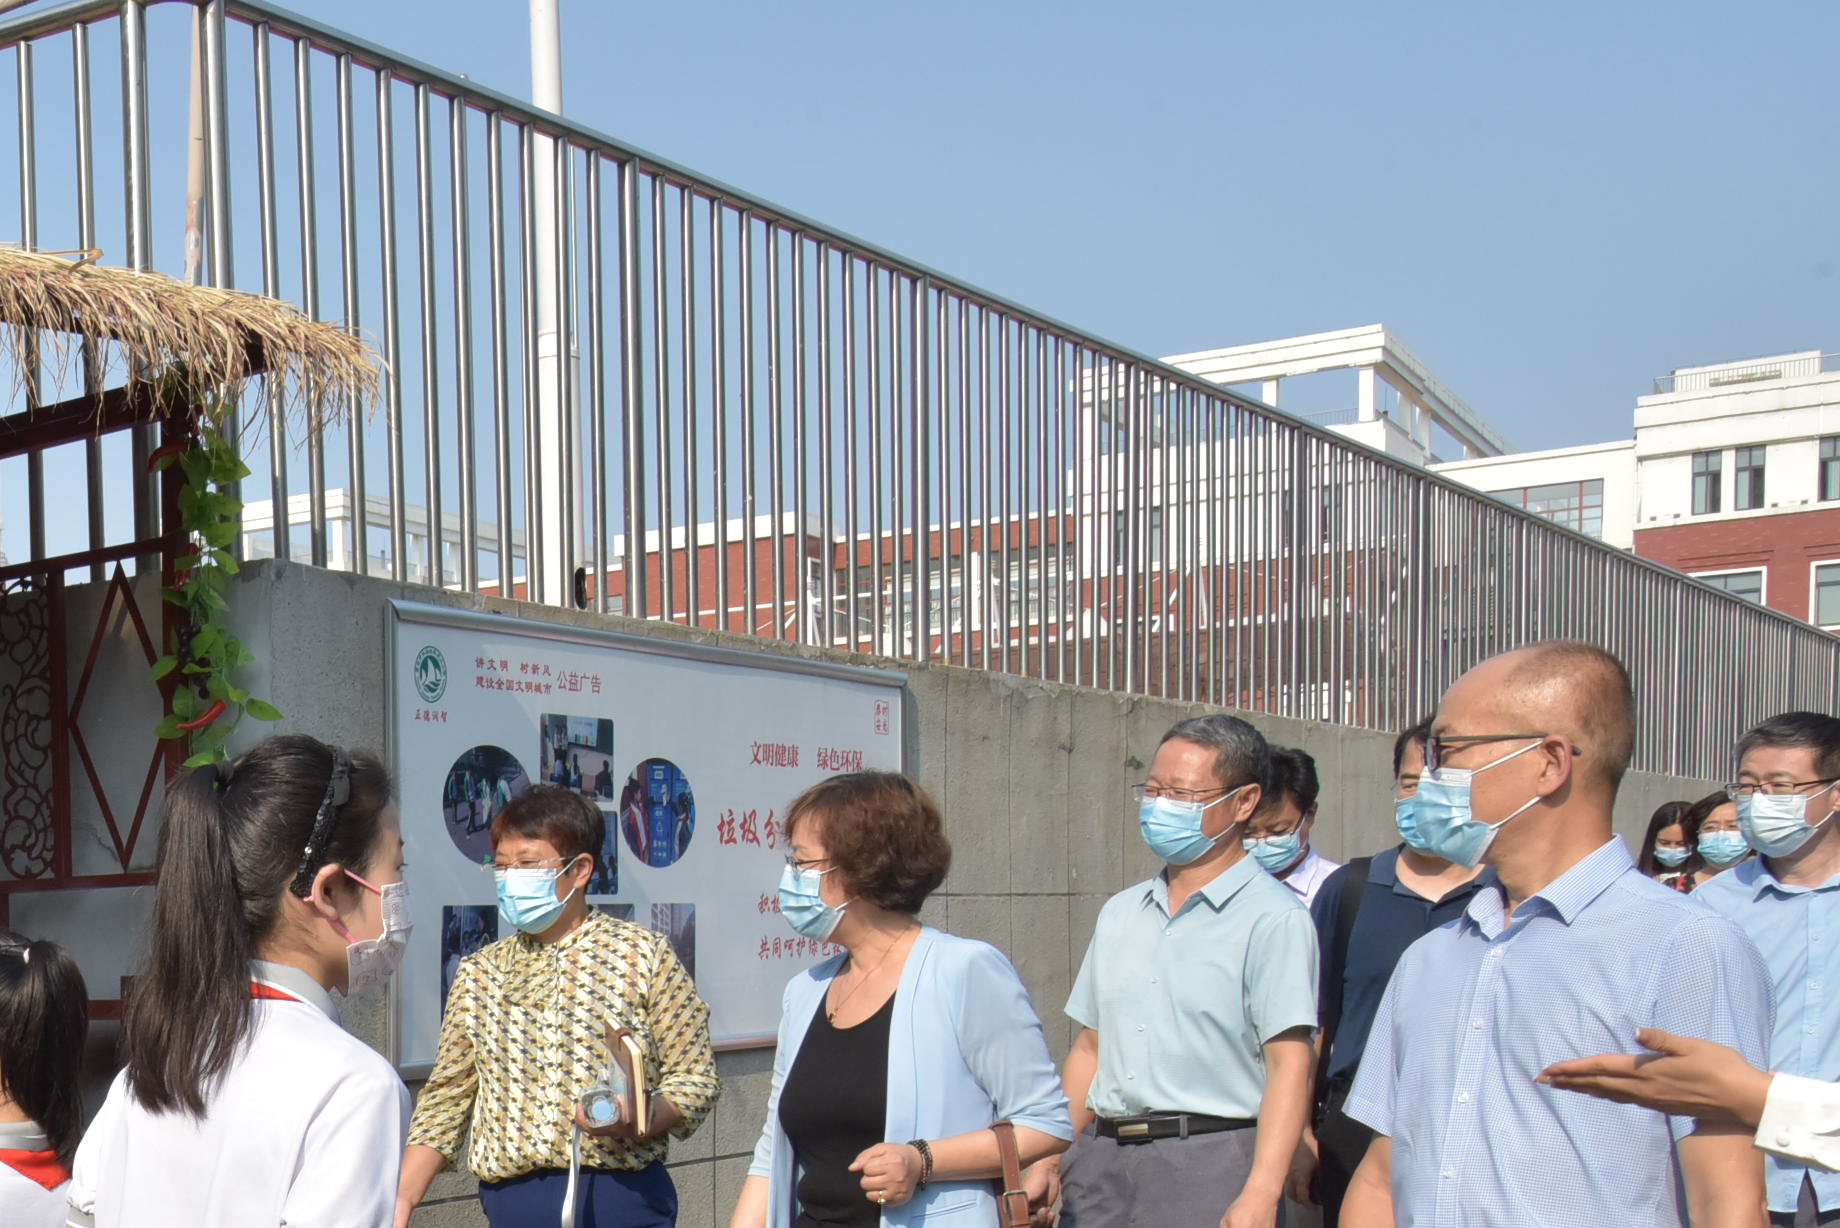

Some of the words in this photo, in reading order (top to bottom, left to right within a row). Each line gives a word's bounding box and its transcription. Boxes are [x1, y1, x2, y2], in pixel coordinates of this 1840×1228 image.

[474, 676, 552, 695] 建设全国文明城市
[556, 671, 602, 694] 公益广告
[750, 740, 800, 769] 文明健康
[816, 747, 863, 773] 绿色环保
